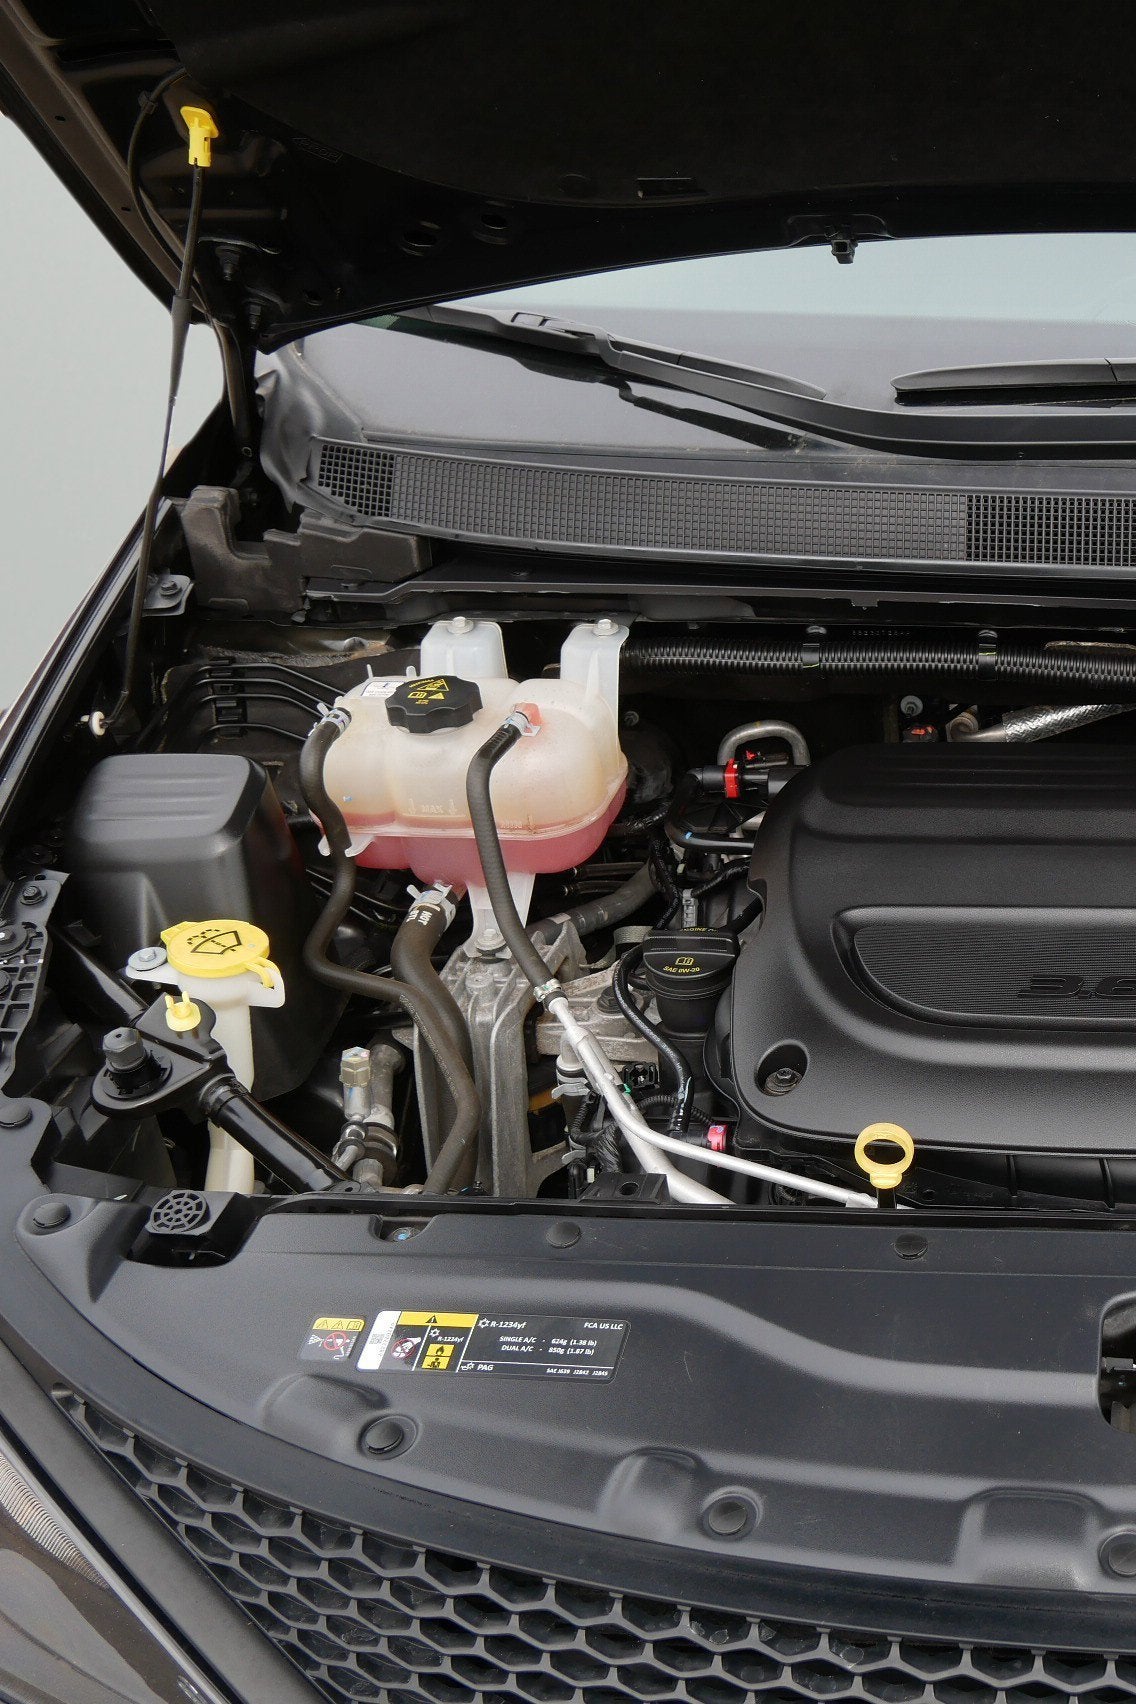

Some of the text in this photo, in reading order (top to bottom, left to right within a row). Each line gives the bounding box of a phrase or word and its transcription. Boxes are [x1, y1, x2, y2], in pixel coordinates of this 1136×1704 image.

[490, 1321, 527, 1330] R-1234yf
[500, 1335, 522, 1343] SINGLE
[523, 1336, 537, 1344] A/C
